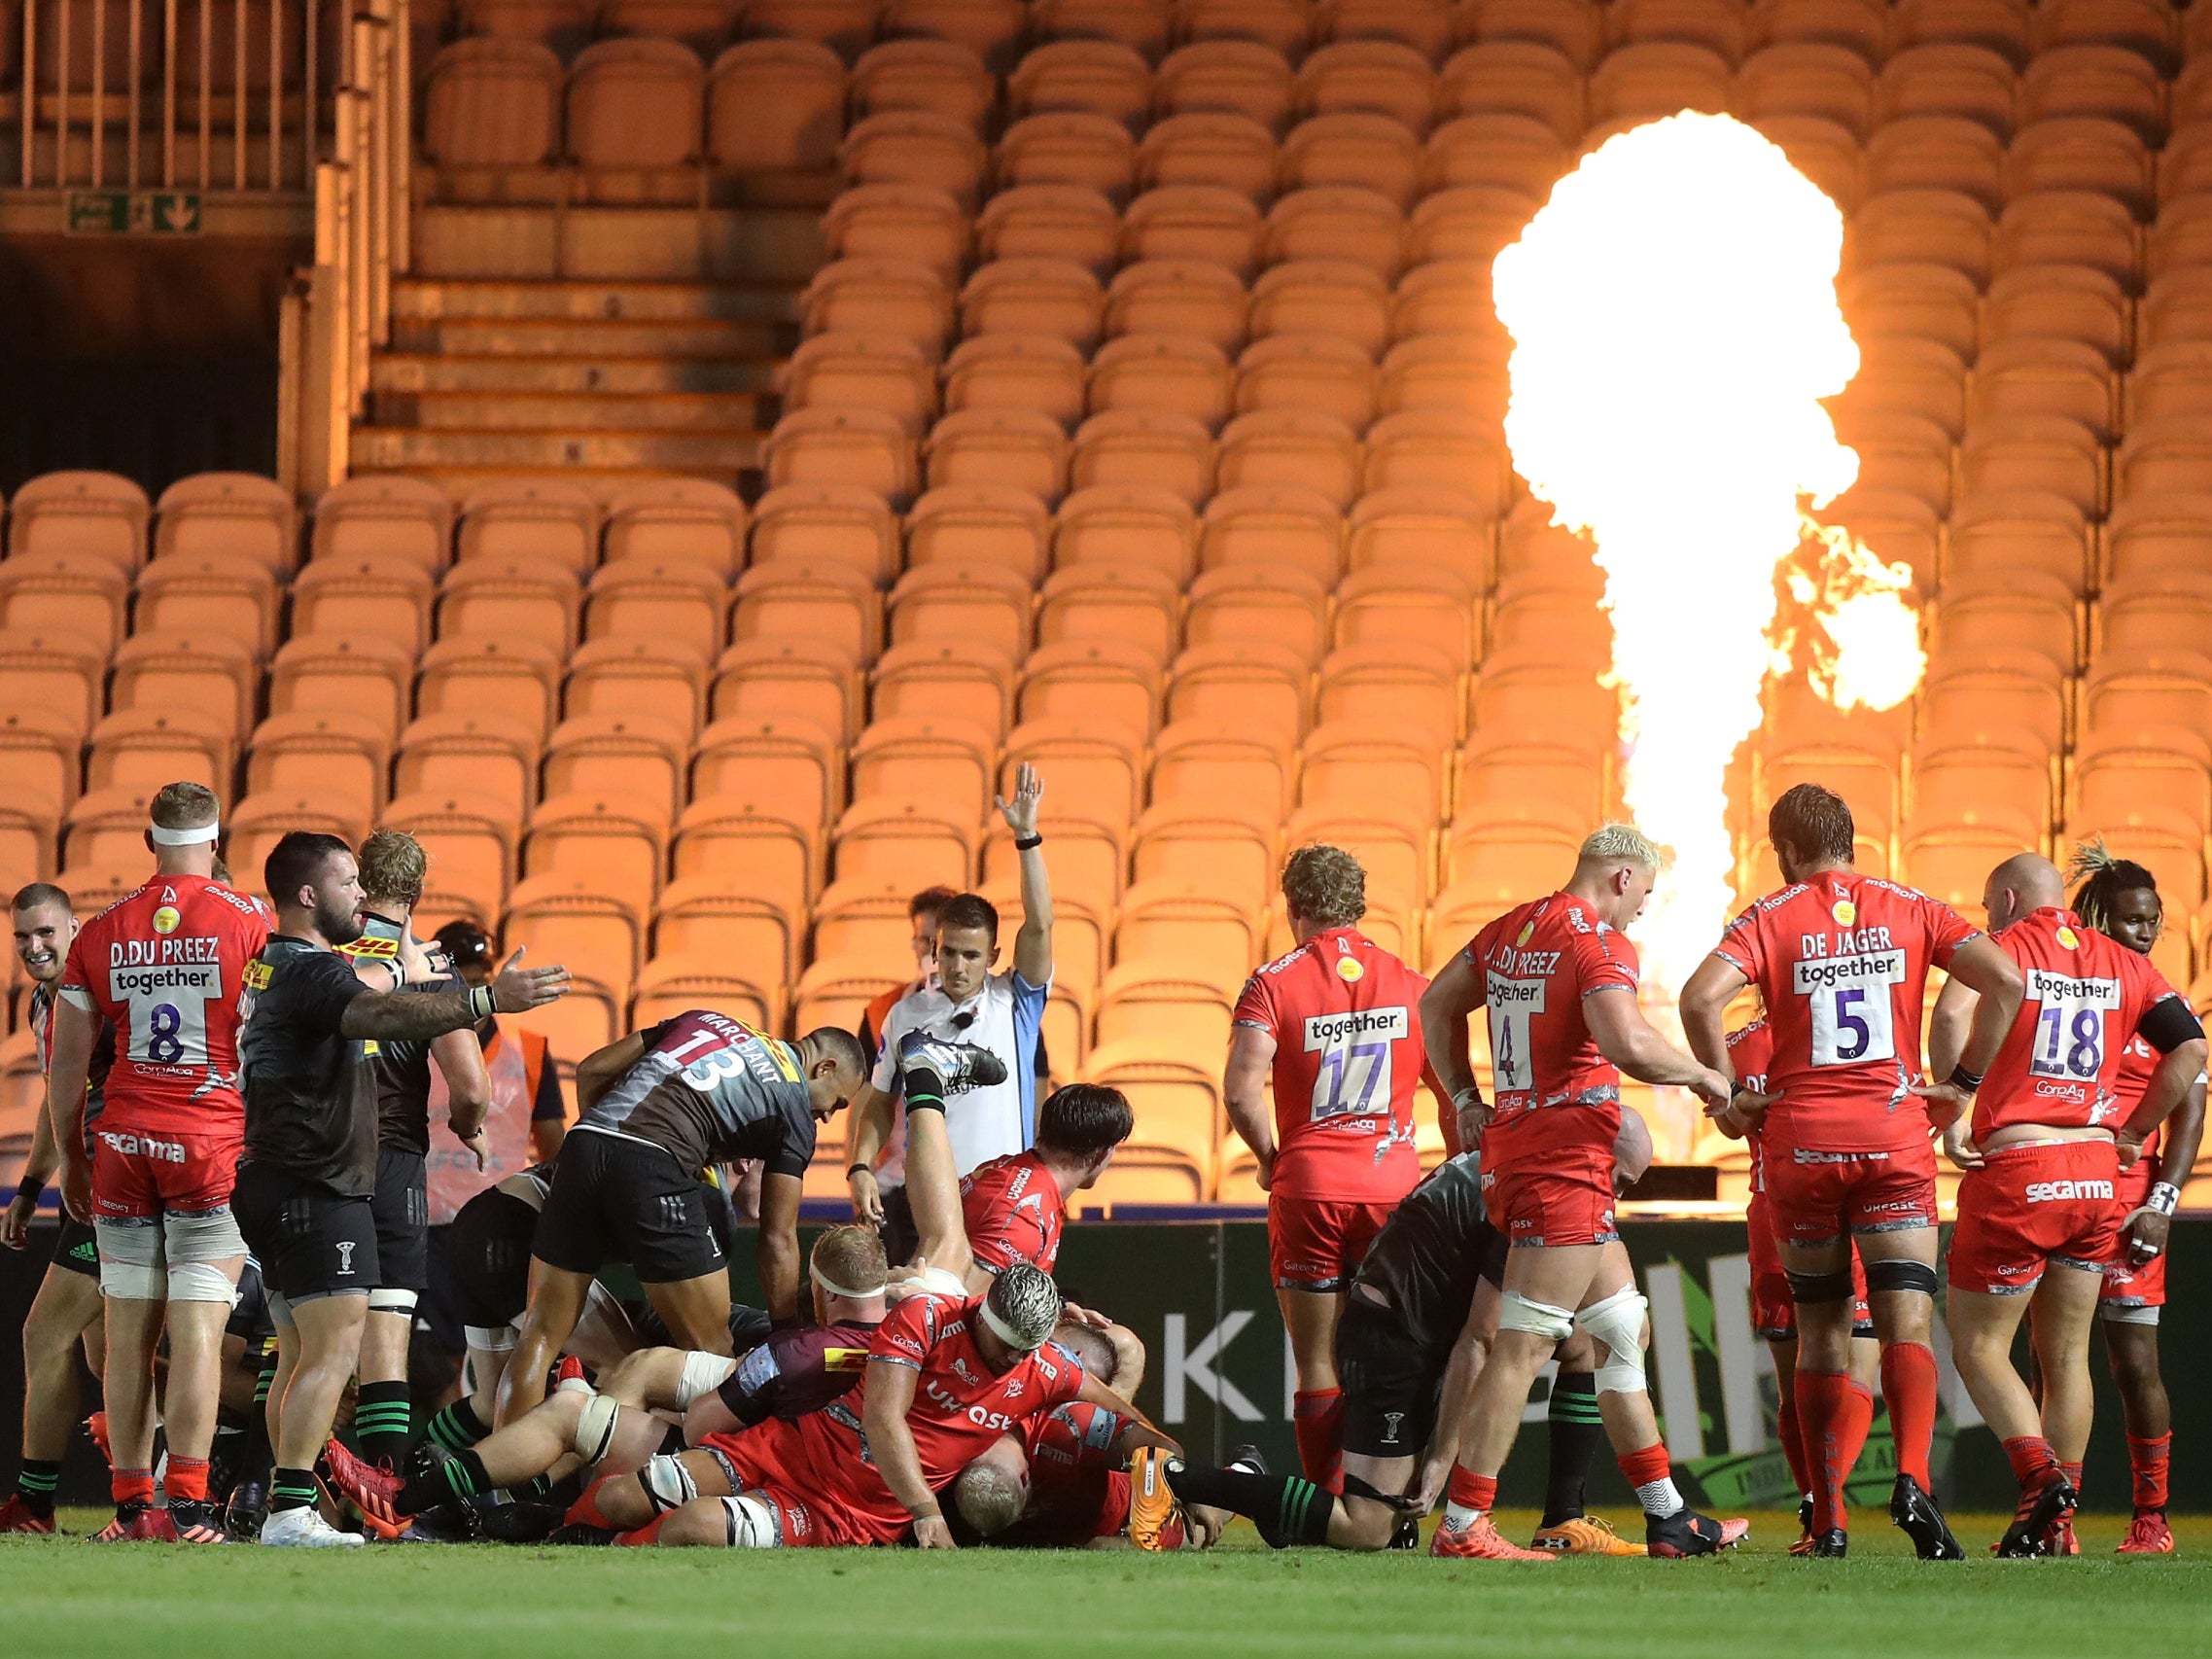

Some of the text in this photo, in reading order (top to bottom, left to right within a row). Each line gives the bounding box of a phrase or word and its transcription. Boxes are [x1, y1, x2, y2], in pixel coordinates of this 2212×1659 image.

[161, 936, 220, 964] PREEZ
[1801, 926, 1894, 960] DE JAGER
[149, 1003, 185, 1064] 8
[697, 1012, 782, 1084] MARCHANT
[1497, 1014, 1516, 1087] 4
[1835, 988, 1870, 1060] 5
[2033, 1006, 2100, 1077] 18
[651, 1028, 746, 1092] 13
[1315, 1041, 1387, 1117] 17
[2024, 1180, 2115, 1205] secarma
